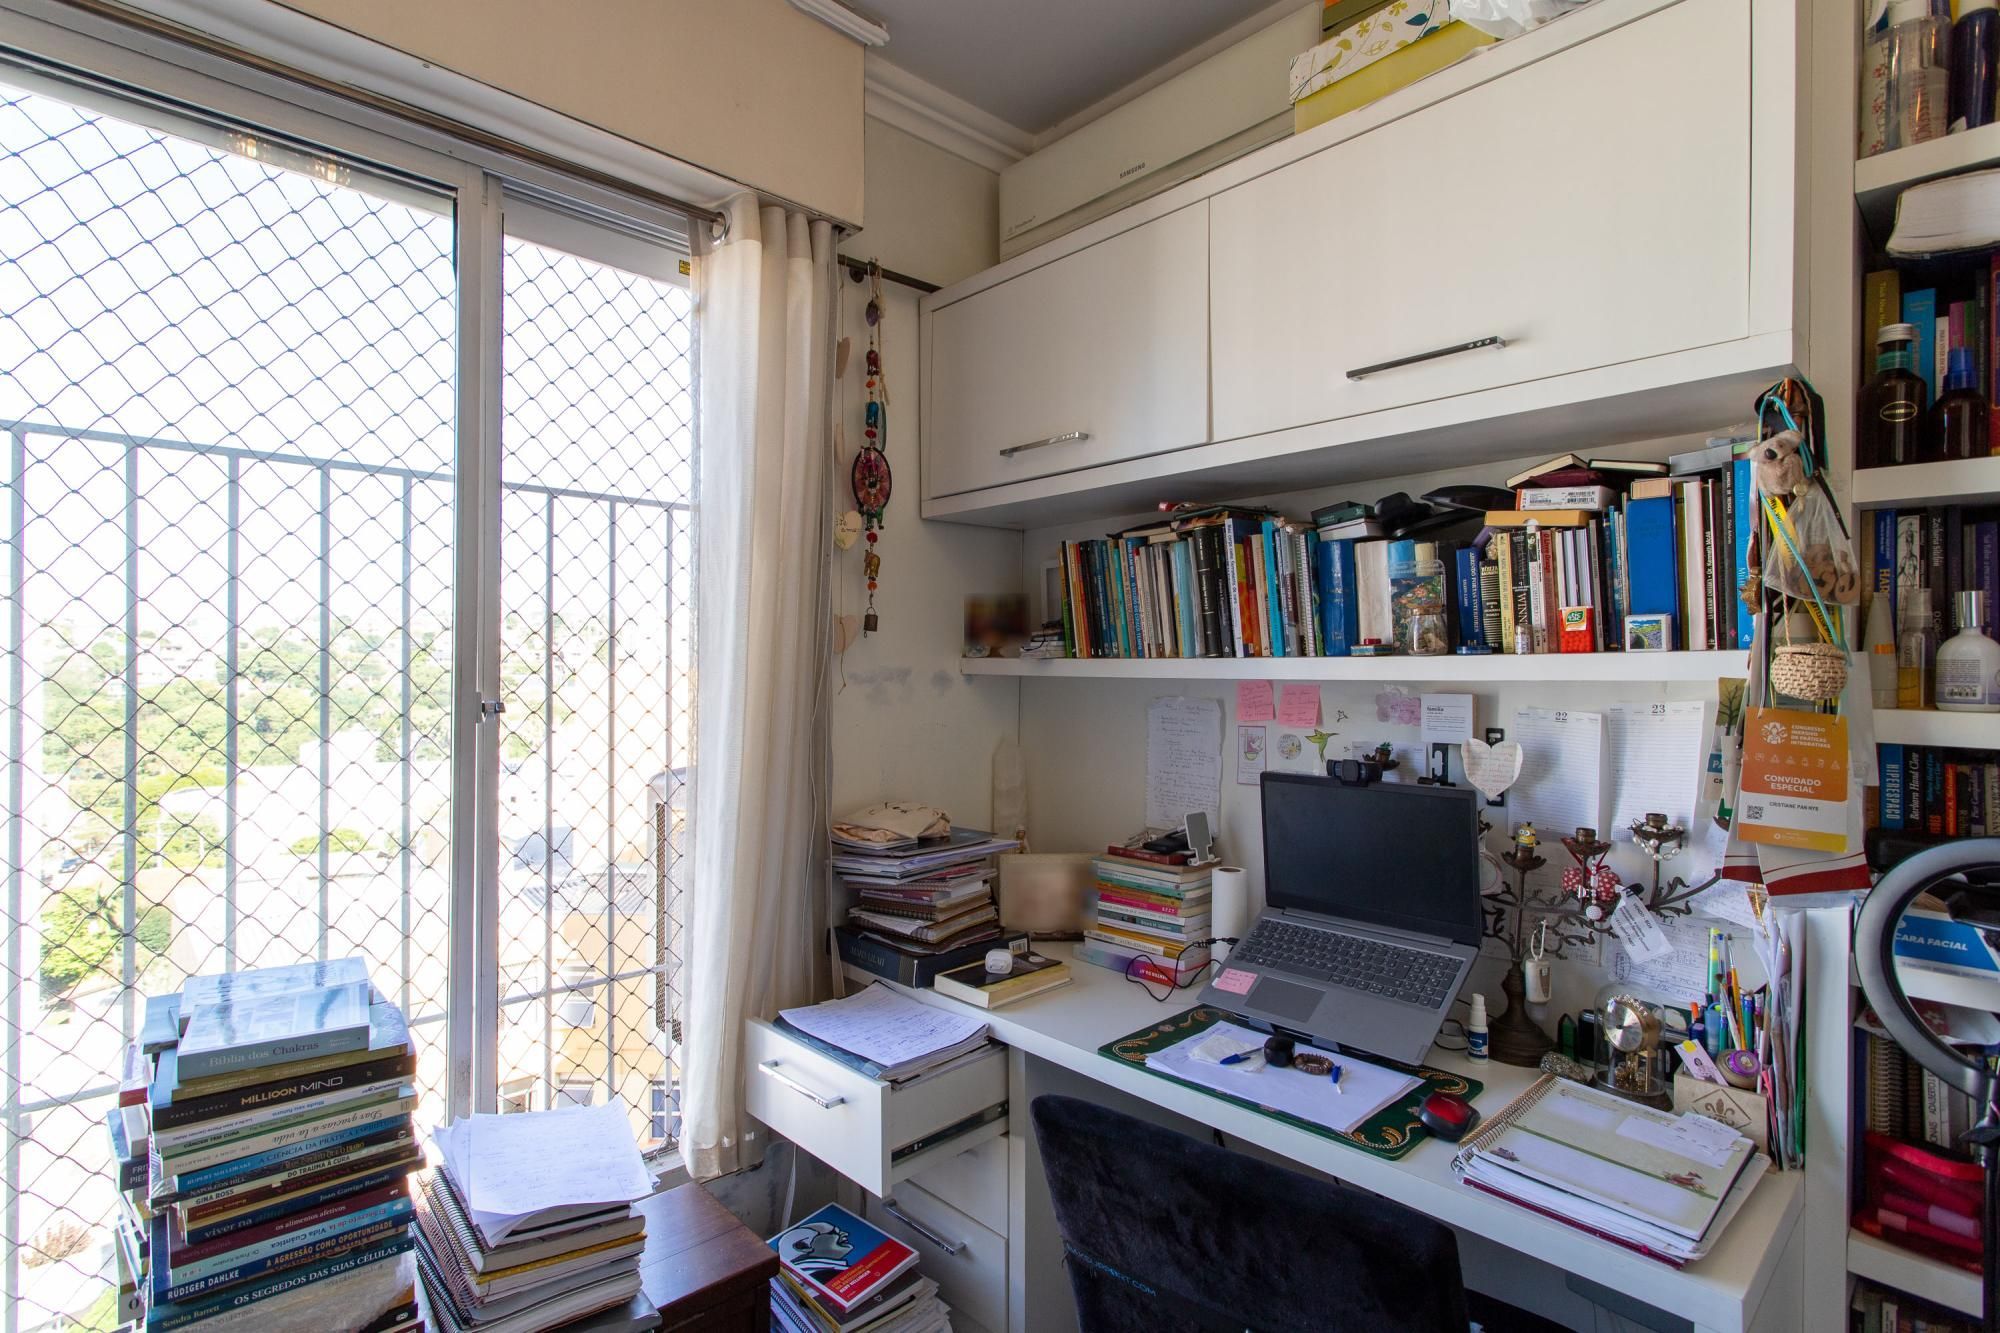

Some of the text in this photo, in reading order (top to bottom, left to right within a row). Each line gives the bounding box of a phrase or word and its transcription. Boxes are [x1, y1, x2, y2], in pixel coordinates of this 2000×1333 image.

[1119, 162, 1146, 179] SAMSUNG
[1555, 712, 1568, 721] 22
[1651, 704, 1666, 714] 23
[1764, 774, 1822, 786] CONVIDADO
[1770, 782, 1815, 794] ESPECIAL
[1908, 770, 1919, 791] Hand
[1769, 801, 1796, 809] CRISTIANE
[1909, 792, 1920, 820] Barbara
[1927, 938, 1968, 951] FACIAL
[272, 1041, 319, 1056] Chakras
[300, 1076, 343, 1093] MIND
[320, 1113, 358, 1131] gracias
[272, 1132, 295, 1144] vida
[287, 1169, 298, 1178] DO
[299, 1161, 326, 1175] TRAUMA
[333, 1155, 351, 1167] CURA
[195, 1188, 234, 1205] GINA ROSS
[285, 1213, 319, 1229] alimentos
[320, 1204, 346, 1219] afetivos
[204, 1222, 236, 1238] viver
[237, 1217, 253, 1227] na
[309, 1226, 327, 1238] Vida
[270, 1232, 307, 1249] Cuántica
[274, 1246, 314, 1267] AGRESSÃO
[315, 1239, 337, 1255] COMO
[338, 1219, 393, 1244] OPORTUNIDADE
[233, 1244, 398, 1306] OS SEGREDOS DAS SUAS CÉLULAS
[167, 1269, 241, 1300] RÜDIGER DAHLKE
[162, 1313, 192, 1329] Sondra
[193, 1304, 220, 1319] Barrett
